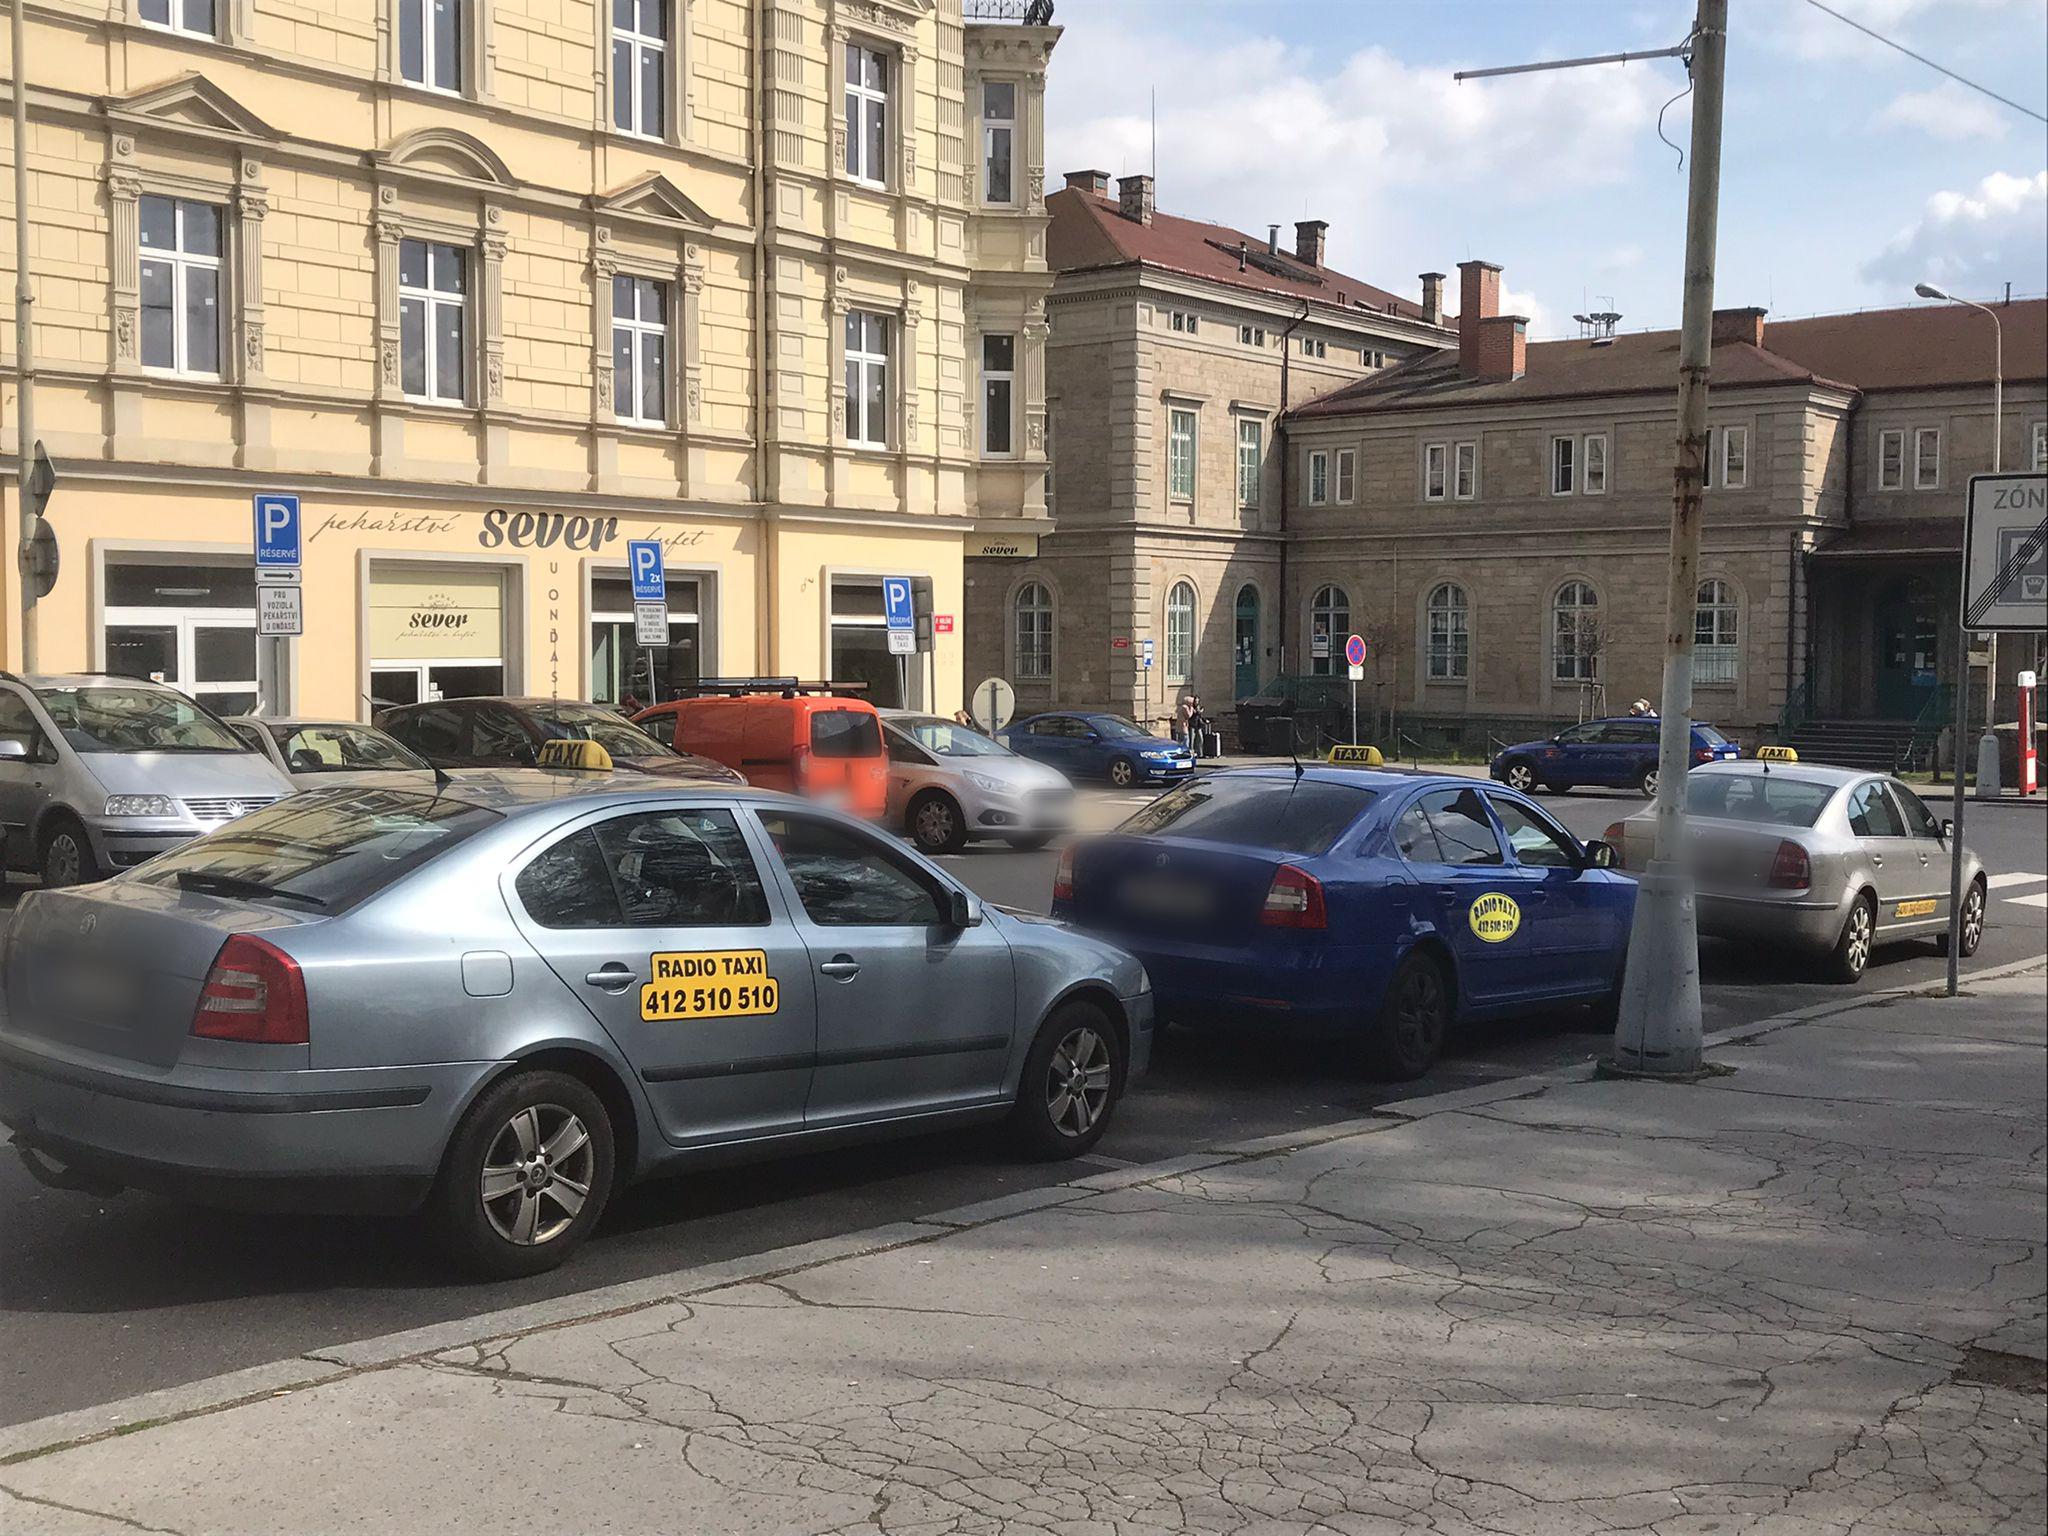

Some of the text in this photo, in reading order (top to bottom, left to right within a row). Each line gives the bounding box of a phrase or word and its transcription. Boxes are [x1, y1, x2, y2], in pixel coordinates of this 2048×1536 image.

[264, 503, 290, 543] P
[308, 510, 461, 543] pekařství
[260, 547, 297, 558] RÉSERVÉ
[636, 548, 656, 581] P
[267, 601, 293, 609] VOZIDLA
[273, 591, 287, 599] PRO
[889, 584, 906, 613] P
[544, 743, 584, 766] TAXI
[1337, 748, 1368, 760] TAXI
[1762, 748, 1788, 757] TAXI
[1473, 897, 1516, 920] RADIO TAXI
[1478, 919, 1513, 933] 412 510 510
[658, 957, 762, 978] RADIO TAXI
[646, 985, 775, 1014] 412 510 510
